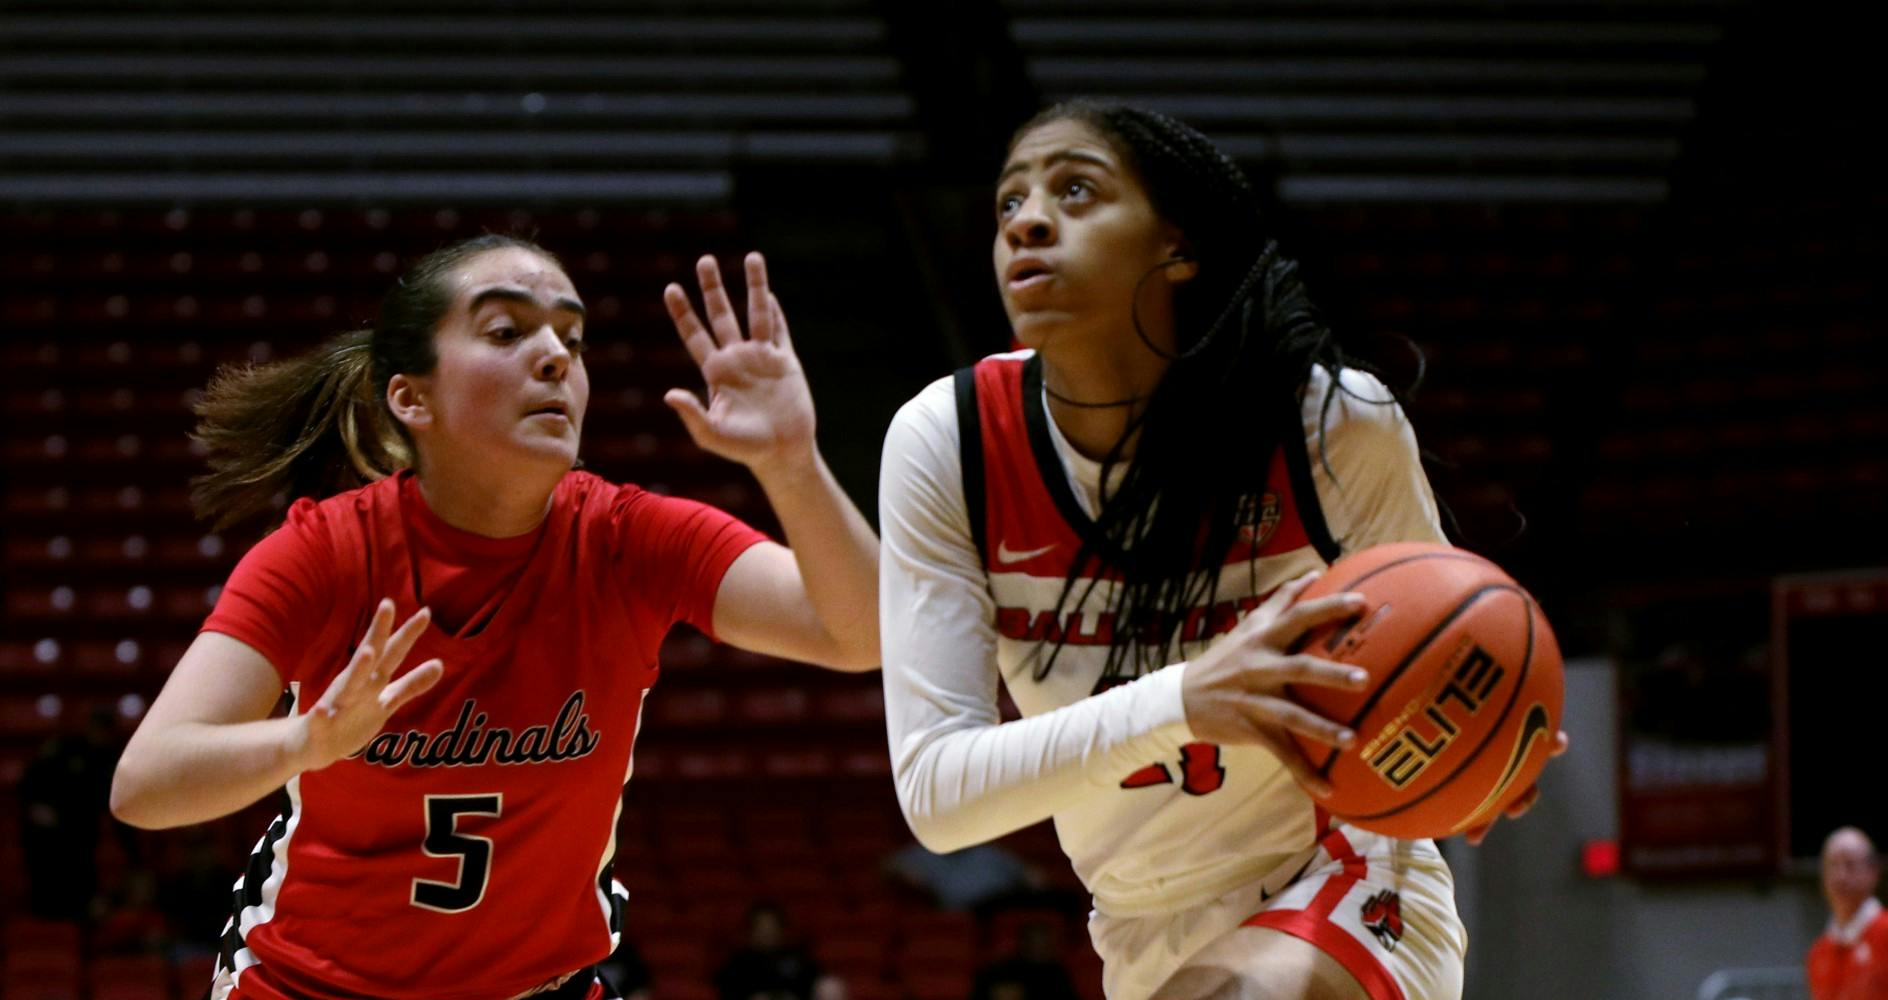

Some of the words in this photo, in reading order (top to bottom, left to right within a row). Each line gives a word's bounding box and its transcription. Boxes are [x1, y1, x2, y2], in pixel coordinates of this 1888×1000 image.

[347, 689, 601, 768] ardinals
[1366, 644, 1504, 790] ELITE
[409, 793, 503, 914] 5
